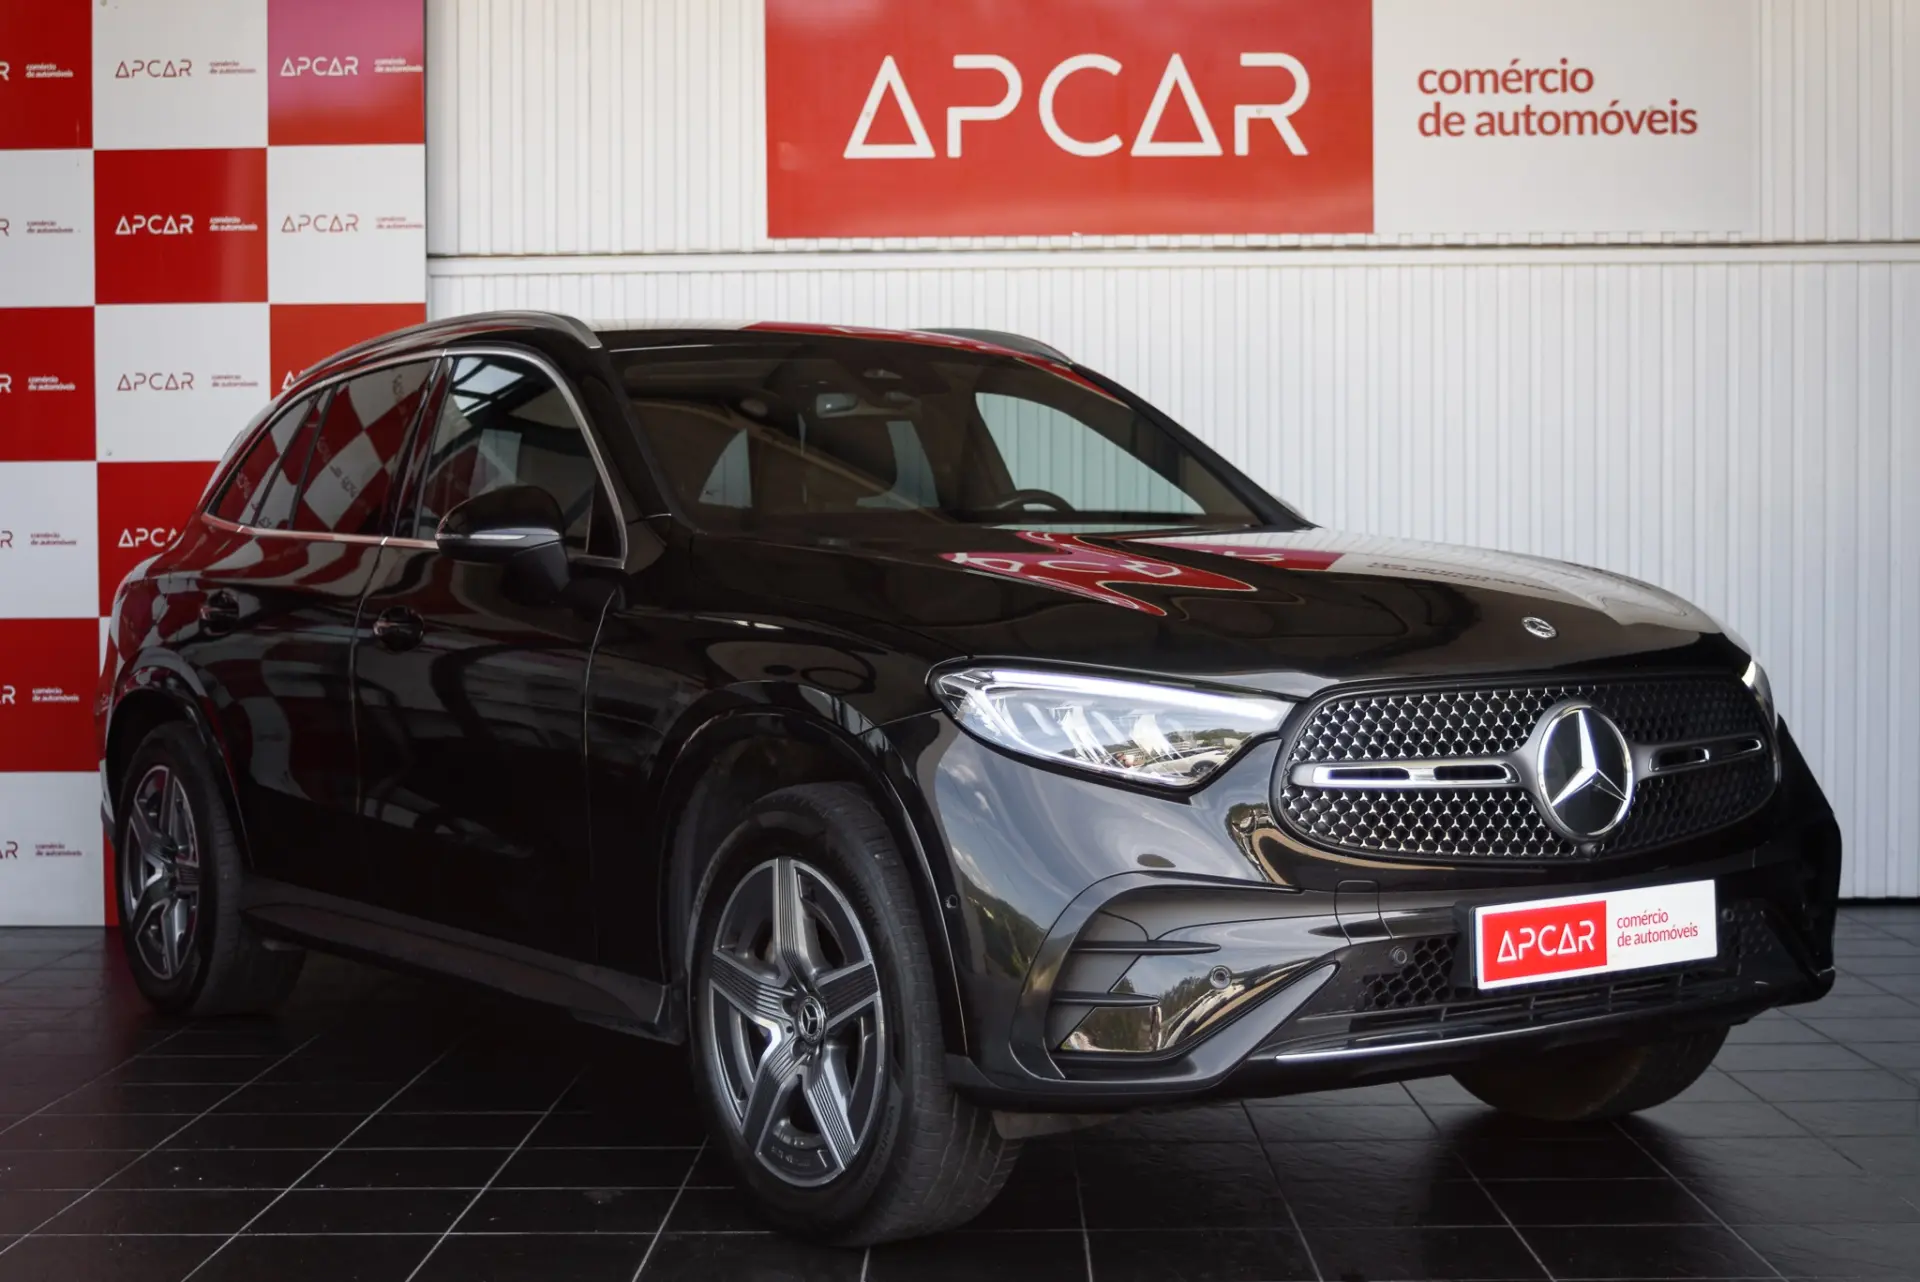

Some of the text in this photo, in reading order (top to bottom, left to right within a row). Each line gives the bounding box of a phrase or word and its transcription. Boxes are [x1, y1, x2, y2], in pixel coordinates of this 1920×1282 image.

[114, 58, 193, 79] APCAR
[280, 56, 359, 77] APCAR
[1418, 57, 1595, 95] comércio
[843, 52, 1311, 160] APCAR
[1418, 98, 1698, 138] de automóveis
[115, 214, 194, 235] APCAR
[281, 213, 359, 233] APCAR
[117, 371, 194, 391] APCAR
[1616, 908, 1669, 929] comércio
[1496, 920, 1596, 963] APCAR
[1616, 922, 1699, 948] de automóveis
